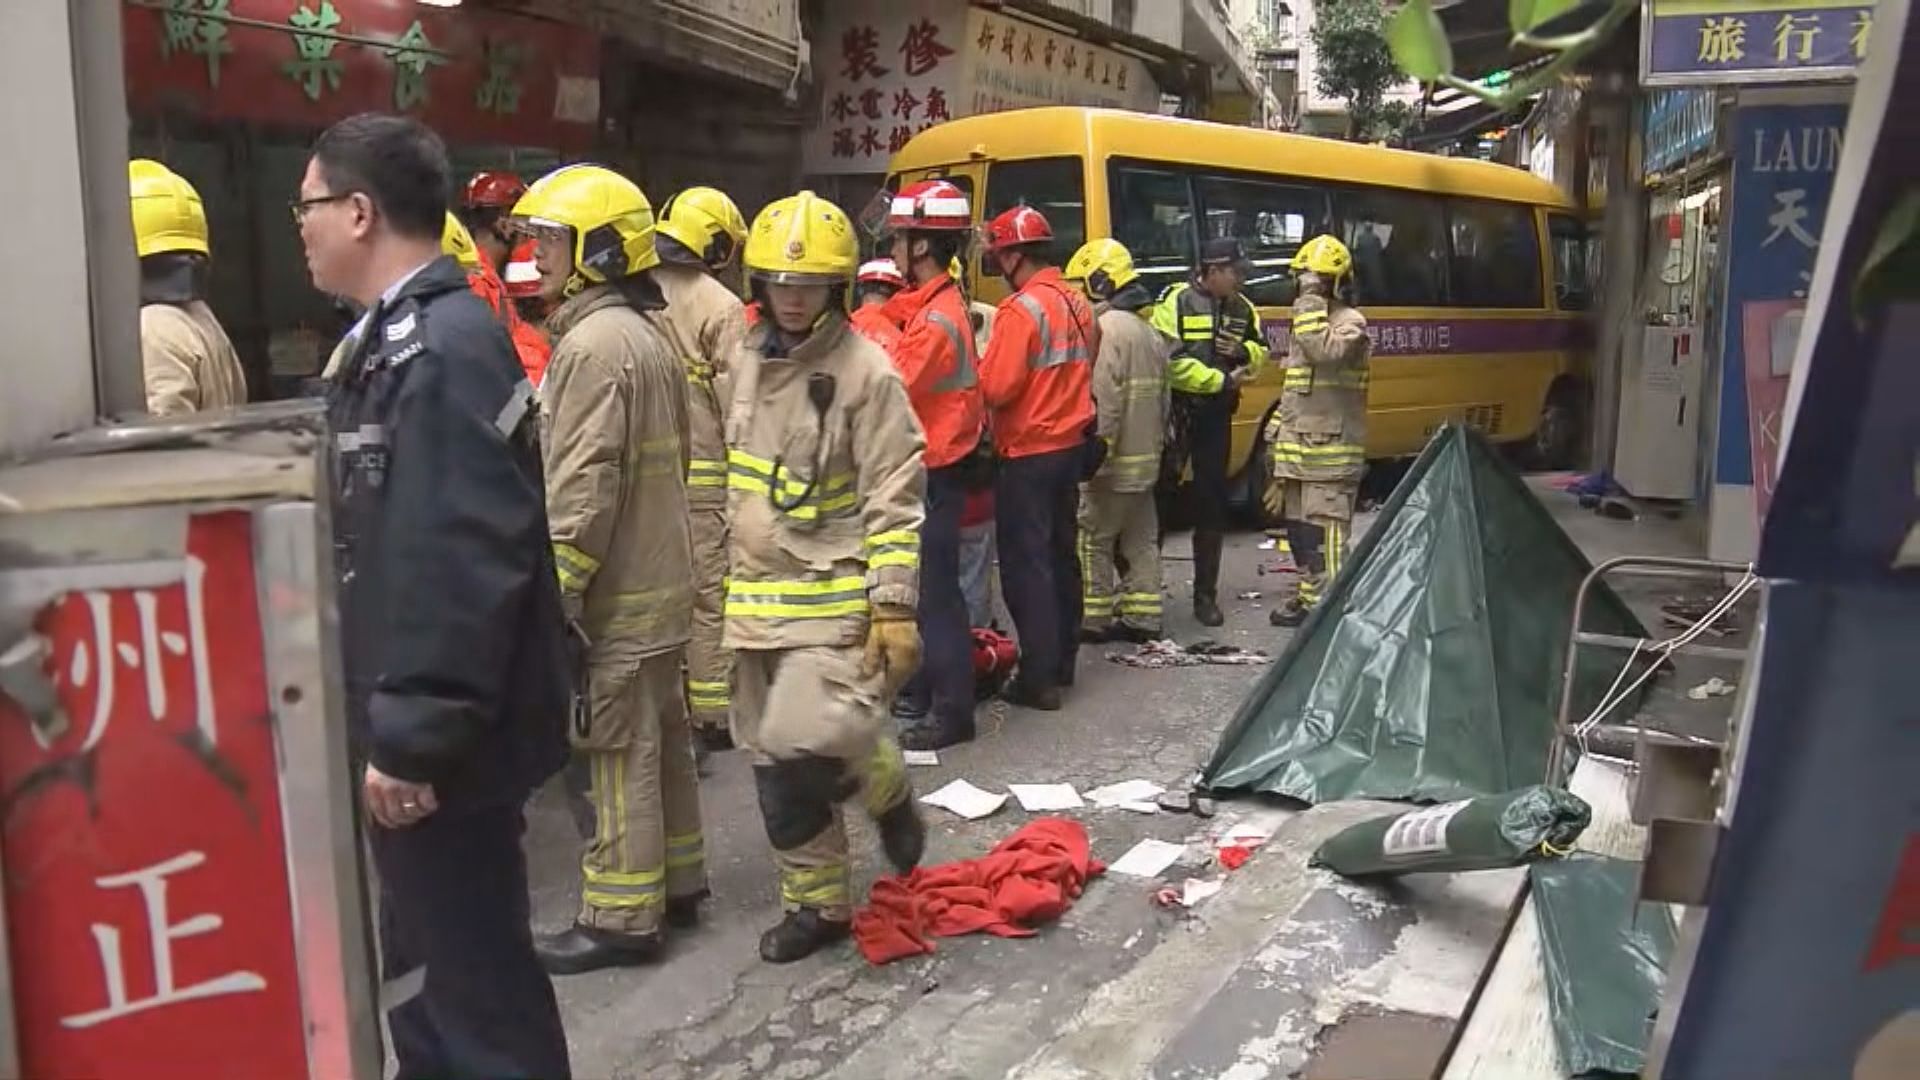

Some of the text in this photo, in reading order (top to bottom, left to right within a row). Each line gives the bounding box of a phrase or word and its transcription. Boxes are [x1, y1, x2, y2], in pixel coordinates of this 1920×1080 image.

[841, 18, 955, 82] 裝修
[830, 87, 950, 121] 水電冷氣
